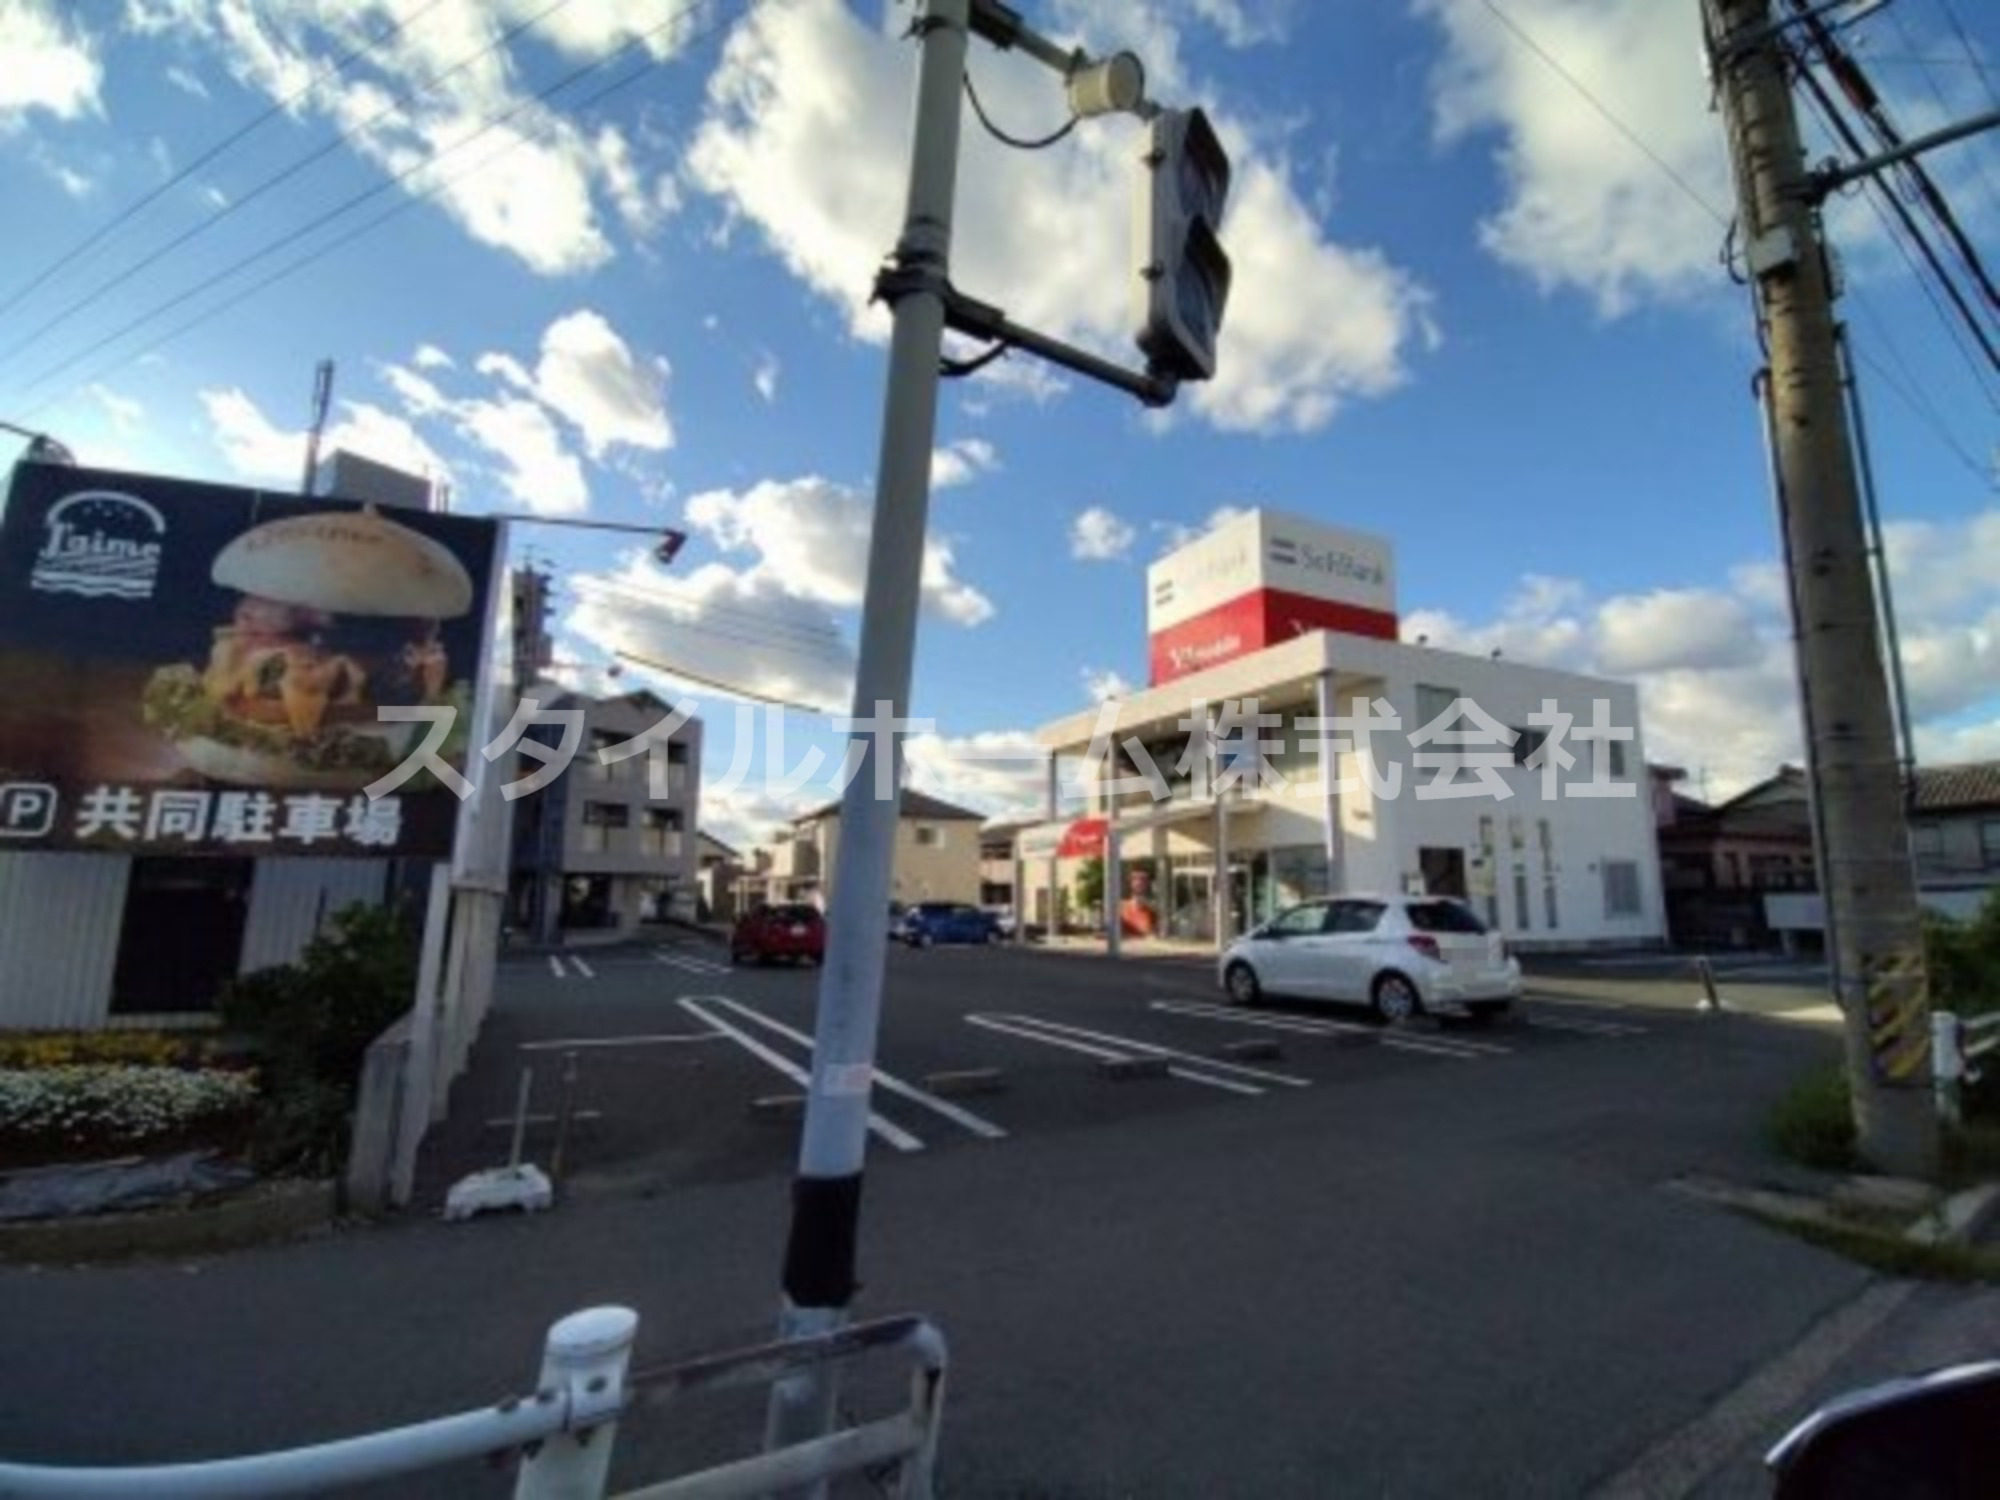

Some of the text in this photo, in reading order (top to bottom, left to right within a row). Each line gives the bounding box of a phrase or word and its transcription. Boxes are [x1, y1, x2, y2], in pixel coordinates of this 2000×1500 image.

[75, 787, 402, 845] 共同駐車場
